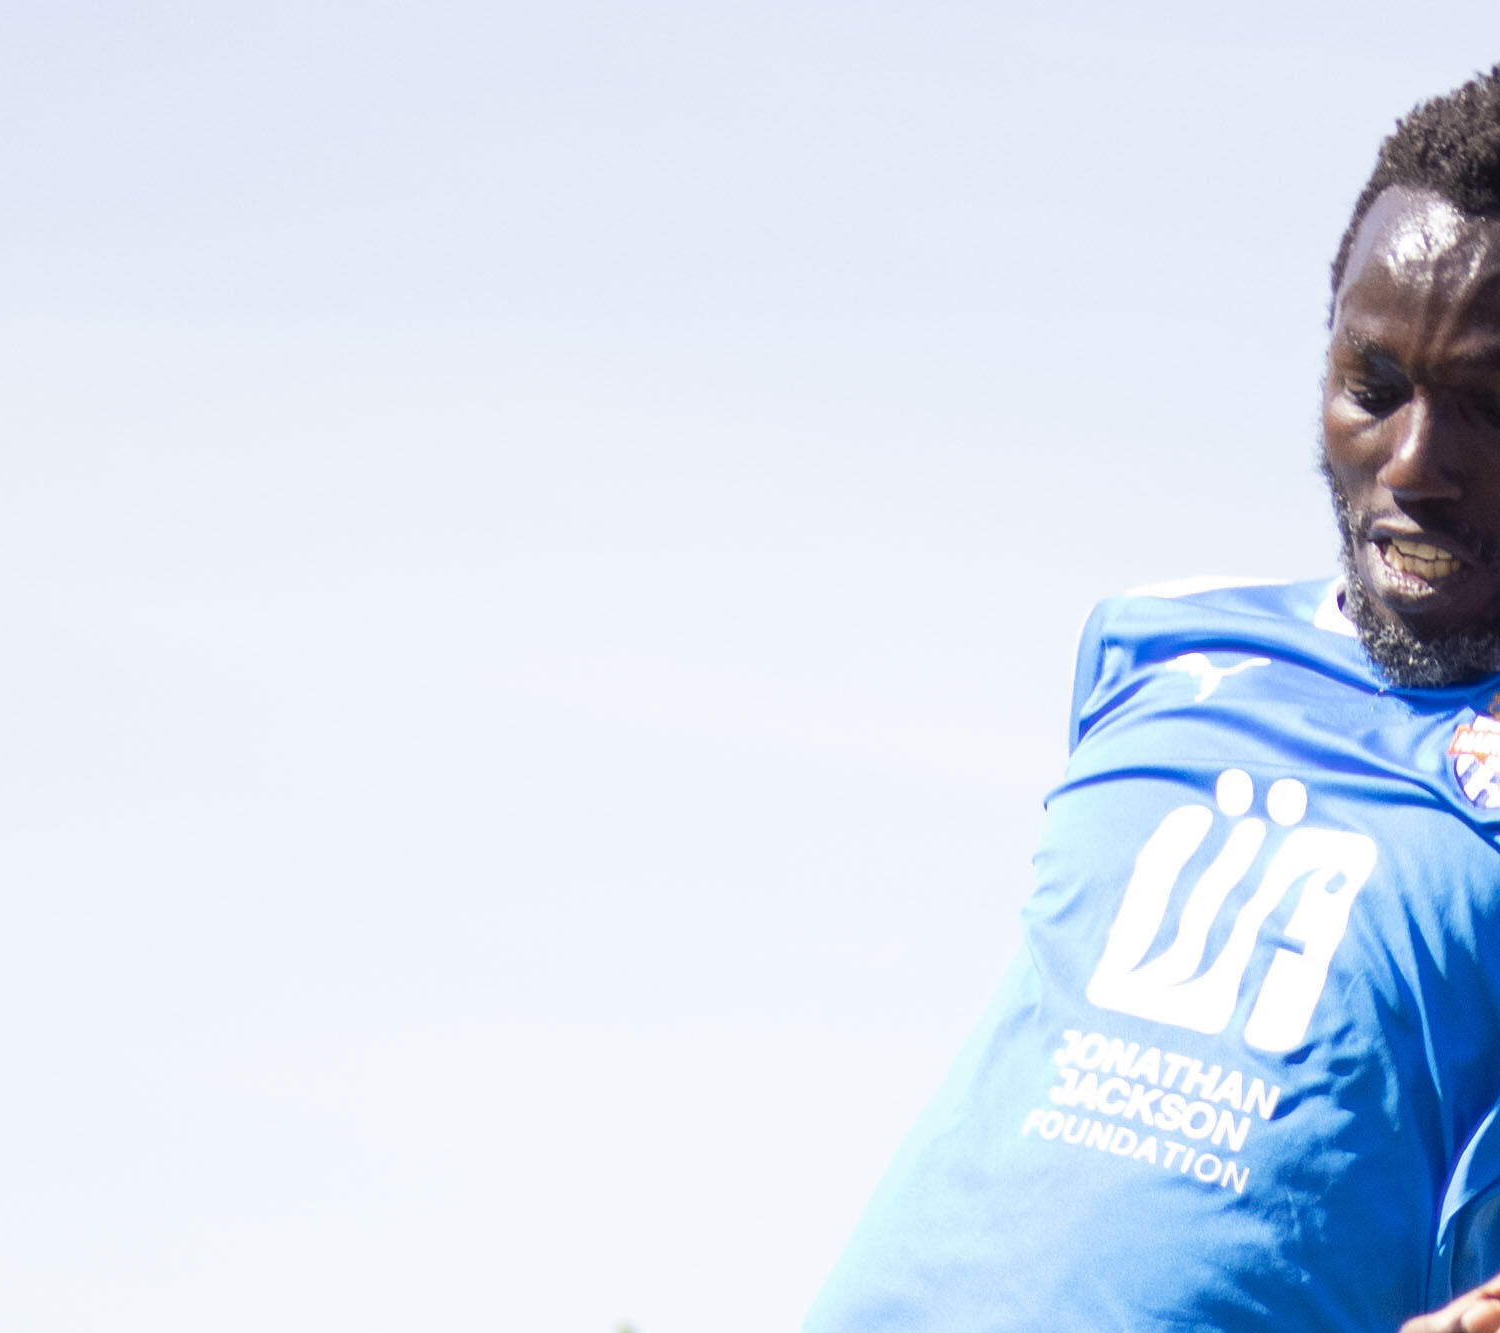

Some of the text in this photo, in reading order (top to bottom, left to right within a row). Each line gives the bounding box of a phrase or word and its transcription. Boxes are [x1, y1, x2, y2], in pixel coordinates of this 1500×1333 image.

[1049, 1067, 1251, 1152] JACKSON
[1053, 1029, 1281, 1121] JONATHAN
[1020, 1109, 1250, 1194] FOUNDATION
